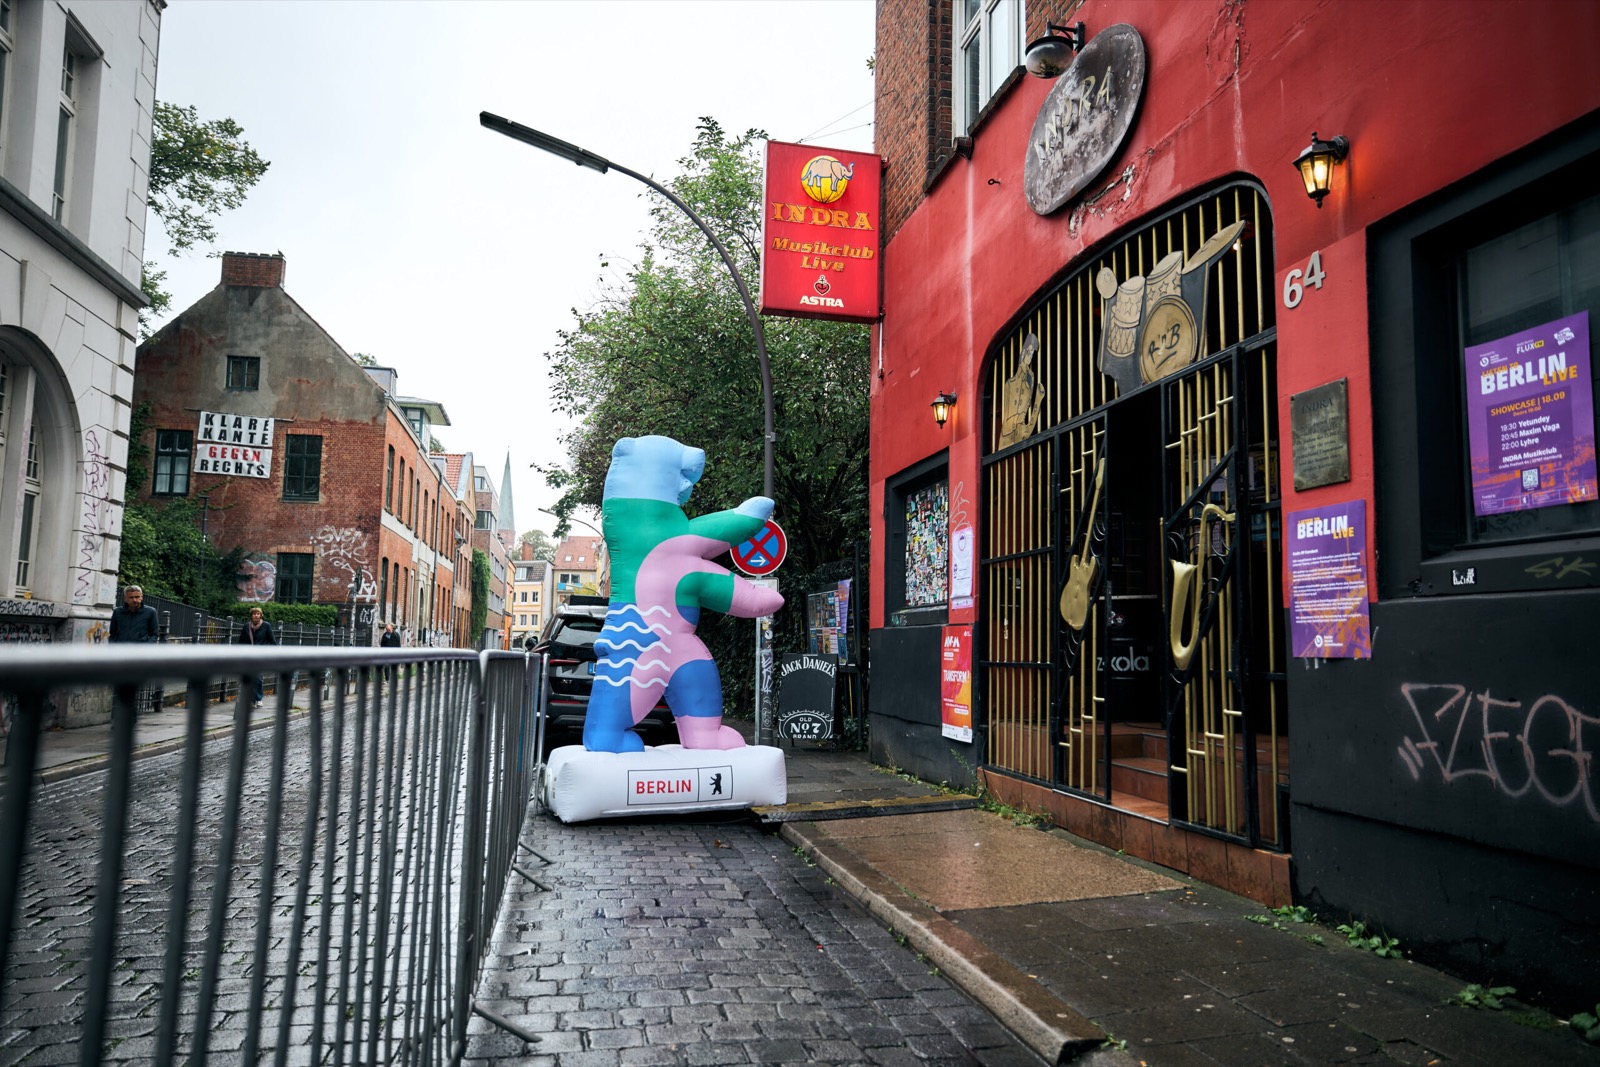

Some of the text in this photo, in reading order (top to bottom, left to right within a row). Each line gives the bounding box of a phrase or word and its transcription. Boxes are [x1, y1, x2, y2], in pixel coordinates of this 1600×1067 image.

[1033, 64, 1113, 167] INDRA
[771, 201, 875, 231] INDRA
[771, 236, 875, 260] Musikclub
[800, 255, 846, 272] Live
[1283, 250, 1326, 309] 64
[799, 295, 844, 308] ASTRA
[1481, 351, 1567, 395] BERLIN
[1543, 365, 1578, 386] LIVE
[1301, 397, 1334, 414] INDRA
[1491, 399, 1536, 416] SHOWCASE
[1541, 391, 1566, 404] 18.09
[204, 413, 270, 432] KLARE
[1518, 416, 1550, 428] Yetundey
[1519, 427, 1542, 437] Maxim
[1542, 423, 1560, 433] Vaga
[203, 427, 269, 445] KANTE
[1519, 437, 1539, 448] Lyhre
[208, 446, 261, 462] GEGEN
[1502, 447, 1557, 463] INDRA Musikclub
[200, 458, 265, 476] RECHTS
[1297, 515, 1348, 539] BERLIN
[1333, 526, 1354, 539] LIVE
[781, 659, 803, 677] JACK
[803, 656, 837, 679] DANIEL'S
[636, 779, 692, 794] BERLIN
